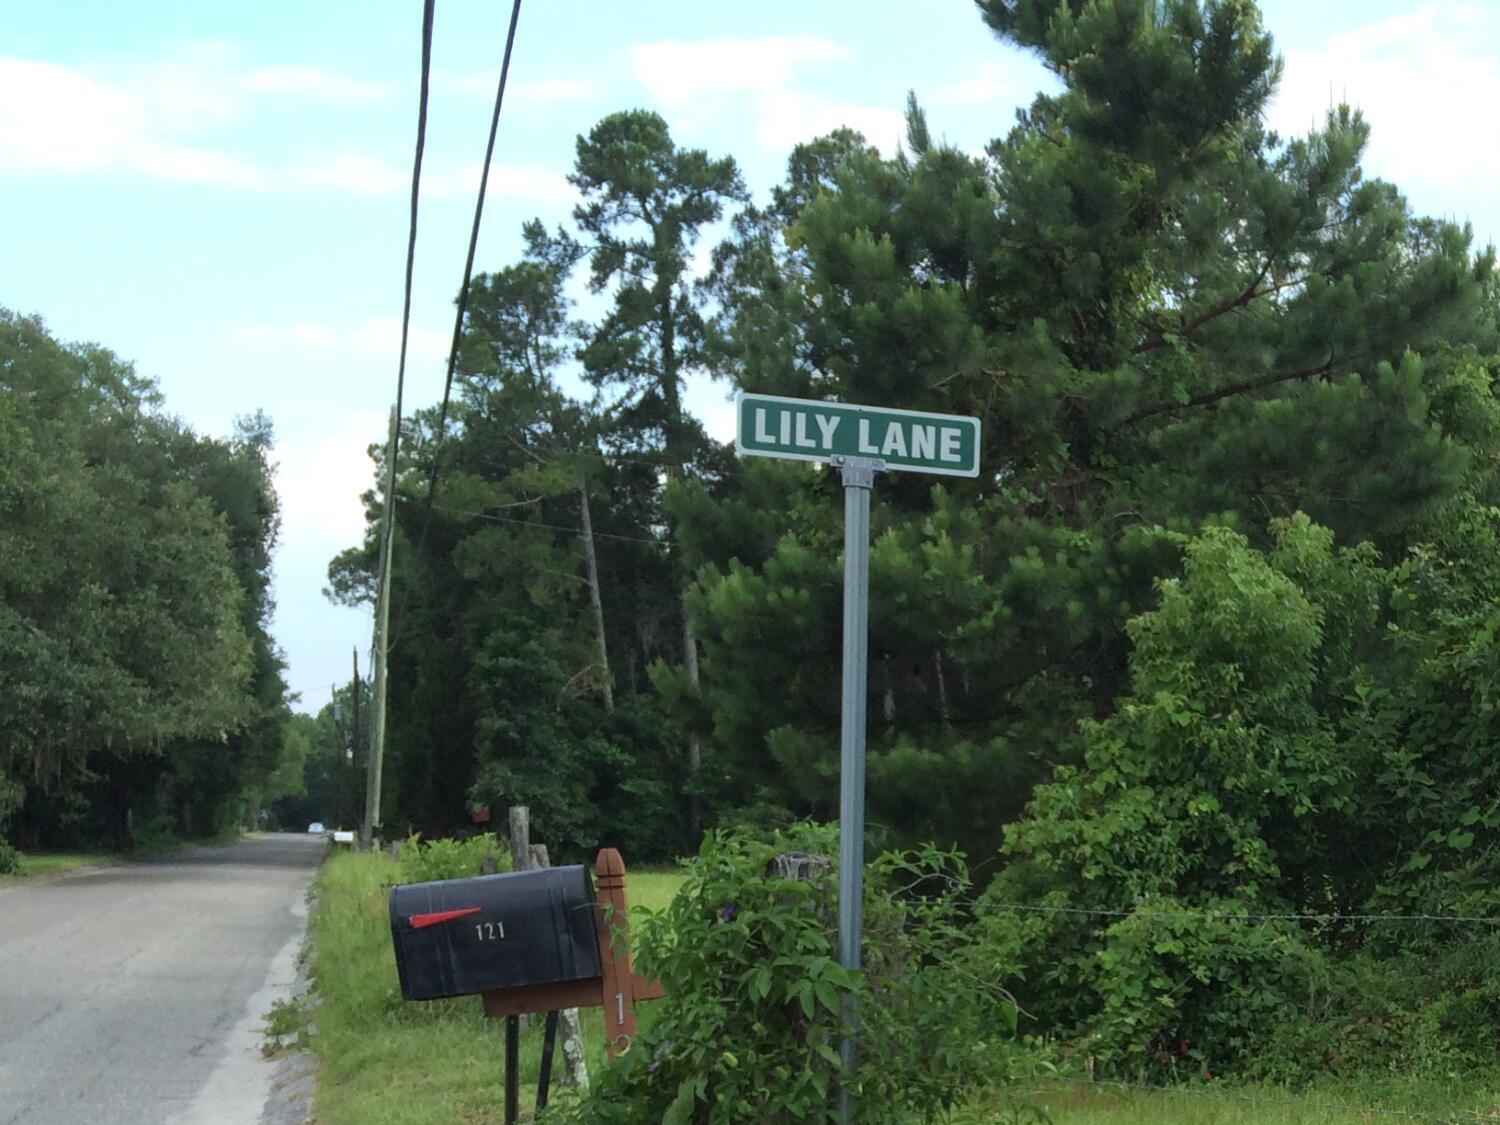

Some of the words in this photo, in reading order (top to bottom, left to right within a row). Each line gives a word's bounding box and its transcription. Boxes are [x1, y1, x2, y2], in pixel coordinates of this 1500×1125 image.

[755, 408, 841, 449] LILY
[858, 419, 962, 462] LANE
[475, 921, 505, 941] 121
